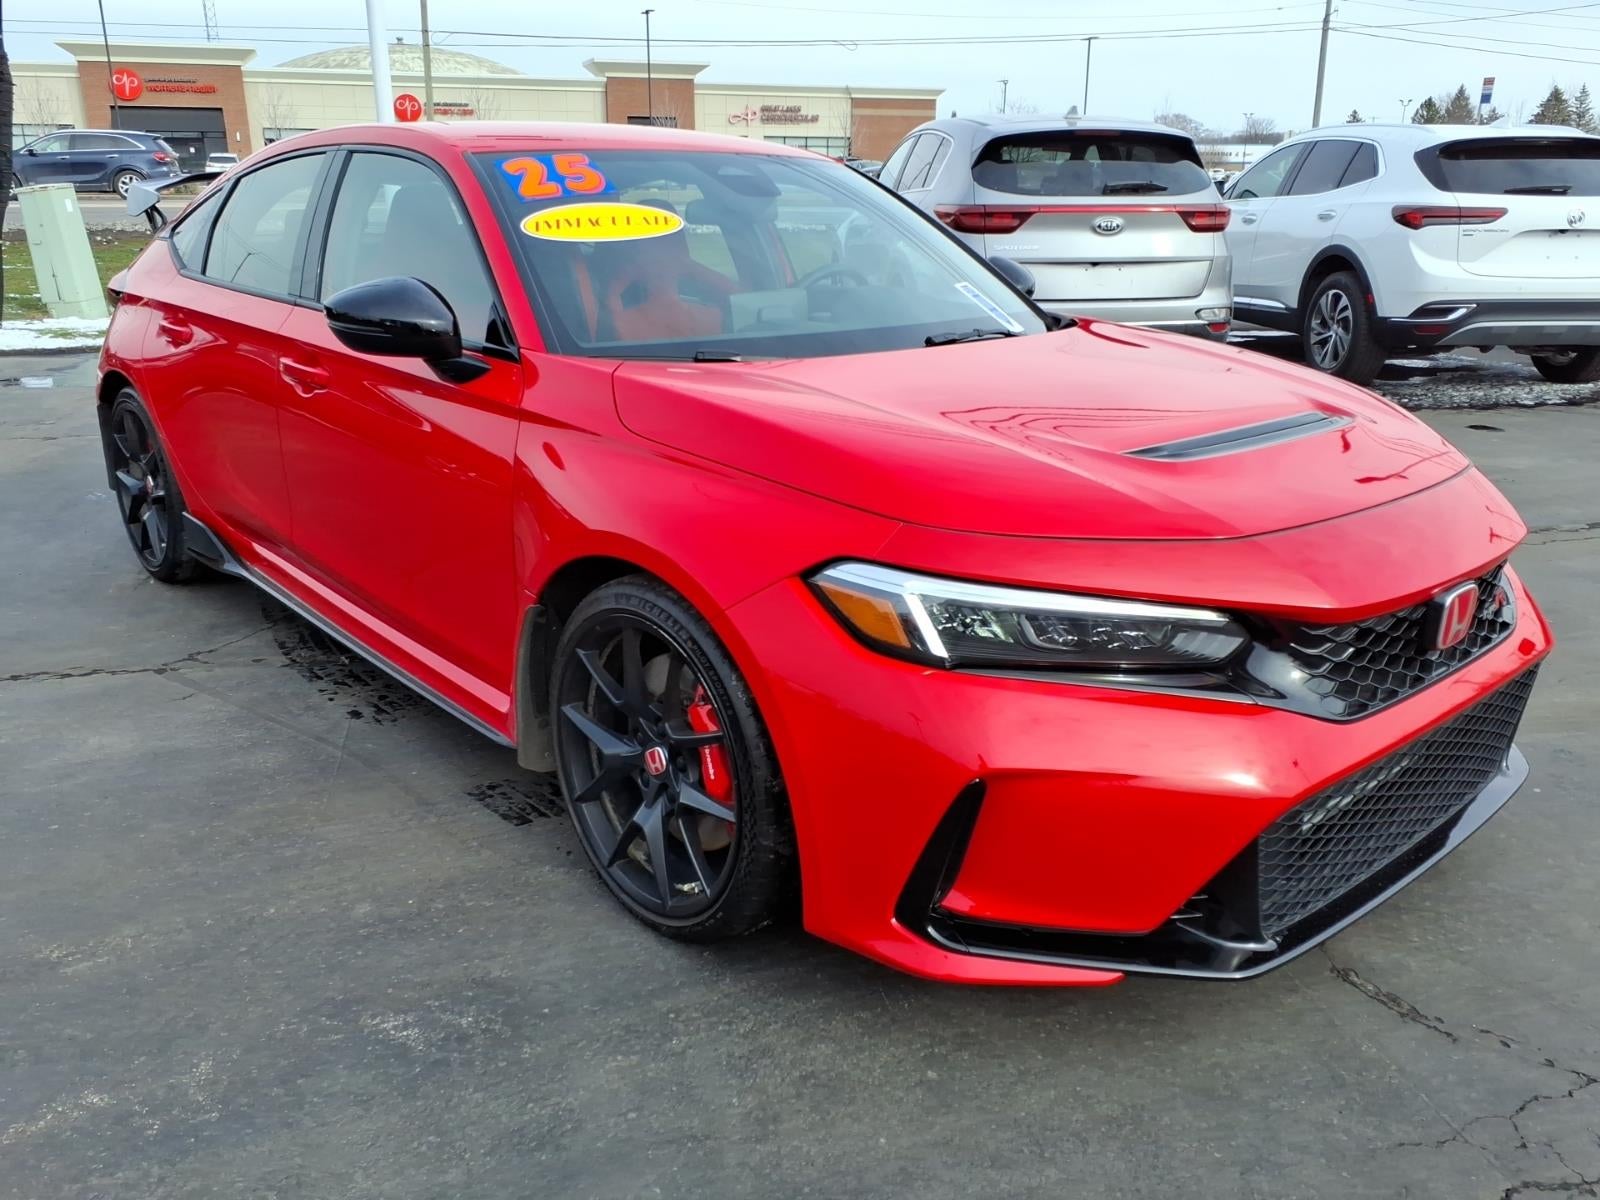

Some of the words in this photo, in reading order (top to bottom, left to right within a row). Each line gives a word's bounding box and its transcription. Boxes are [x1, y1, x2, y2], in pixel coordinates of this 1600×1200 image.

[502, 153, 606, 199] 25
[533, 214, 675, 233] IMMACULATE
[1101, 221, 1118, 230] KIA
[703, 748, 716, 780] brembo
